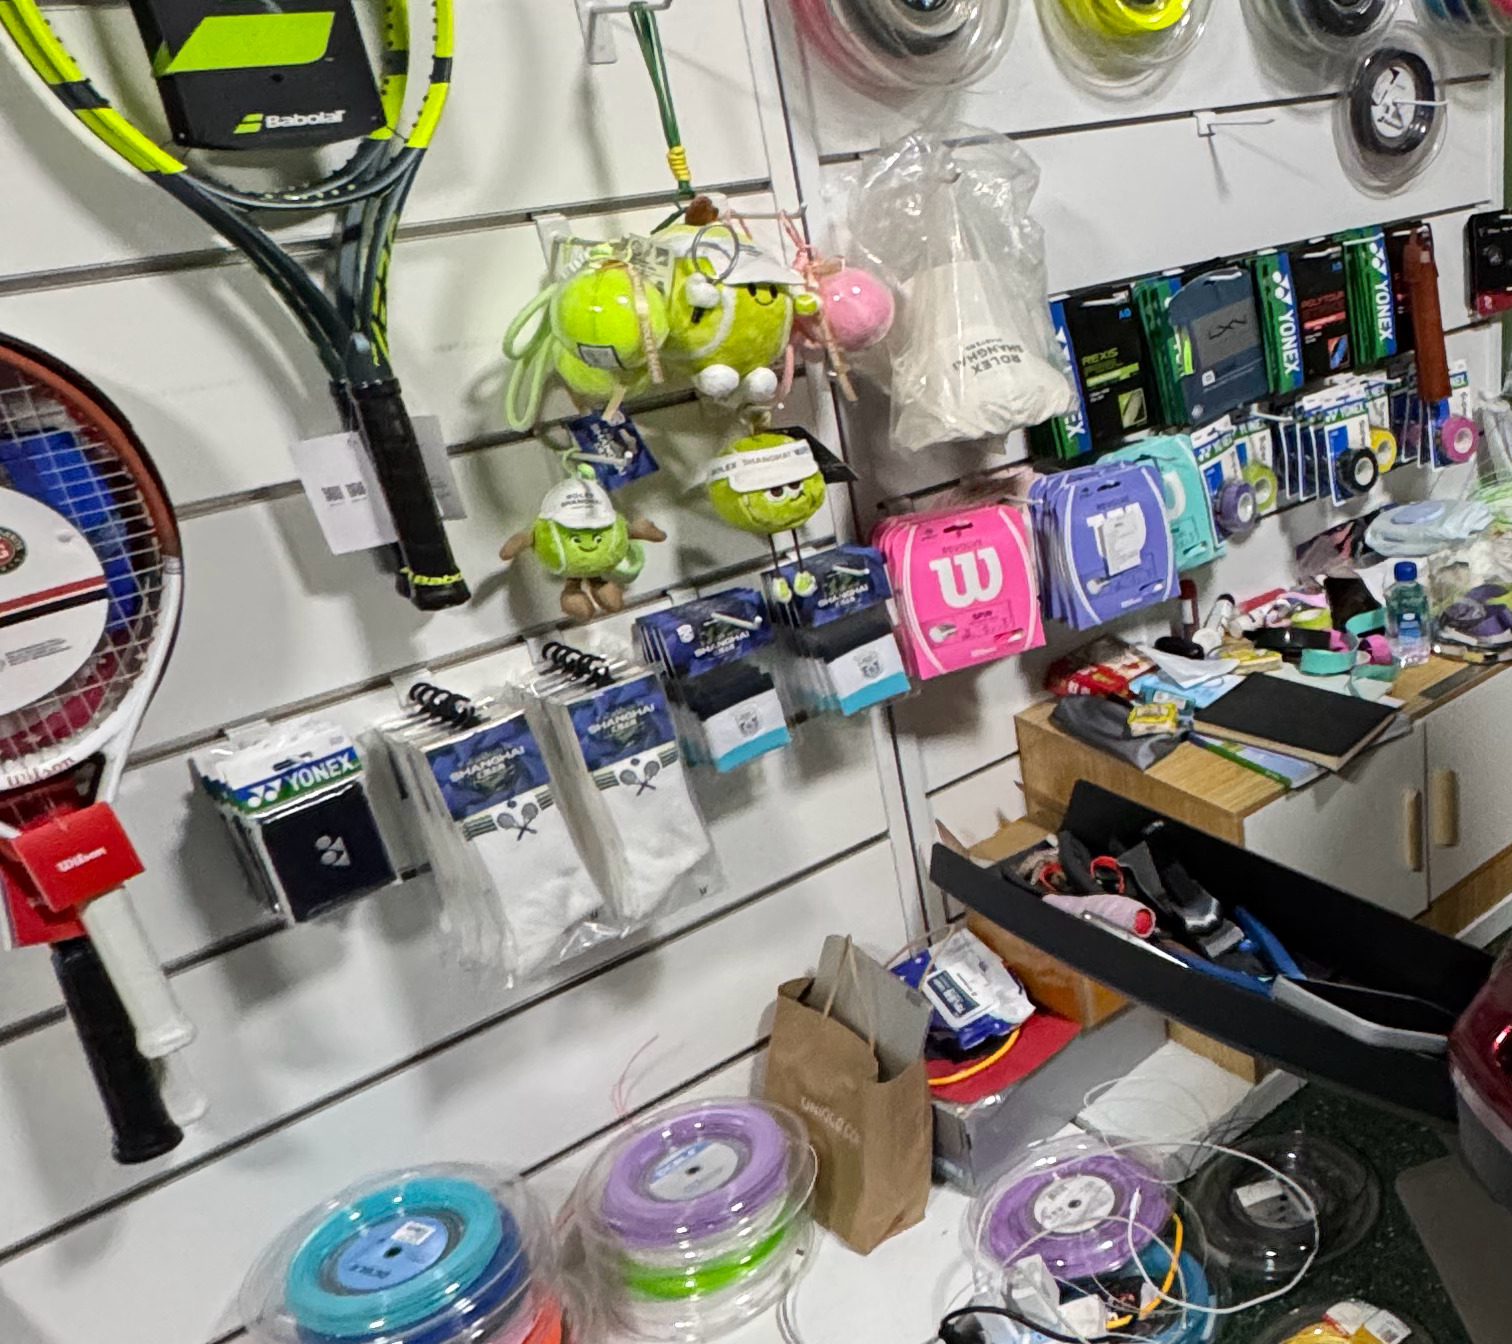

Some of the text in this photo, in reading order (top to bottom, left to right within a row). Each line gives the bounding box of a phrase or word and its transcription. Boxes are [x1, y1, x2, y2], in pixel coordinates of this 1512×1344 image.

[265, 109, 347, 130] Babolat
[1373, 279, 1395, 342] YONEX
[1278, 308, 1301, 375] YONEX
[971, 354, 1022, 376] ROLEX
[588, 703, 655, 735] SHANGHAI
[285, 752, 355, 791] YONEX
[451, 746, 525, 783] SHANGHAI
